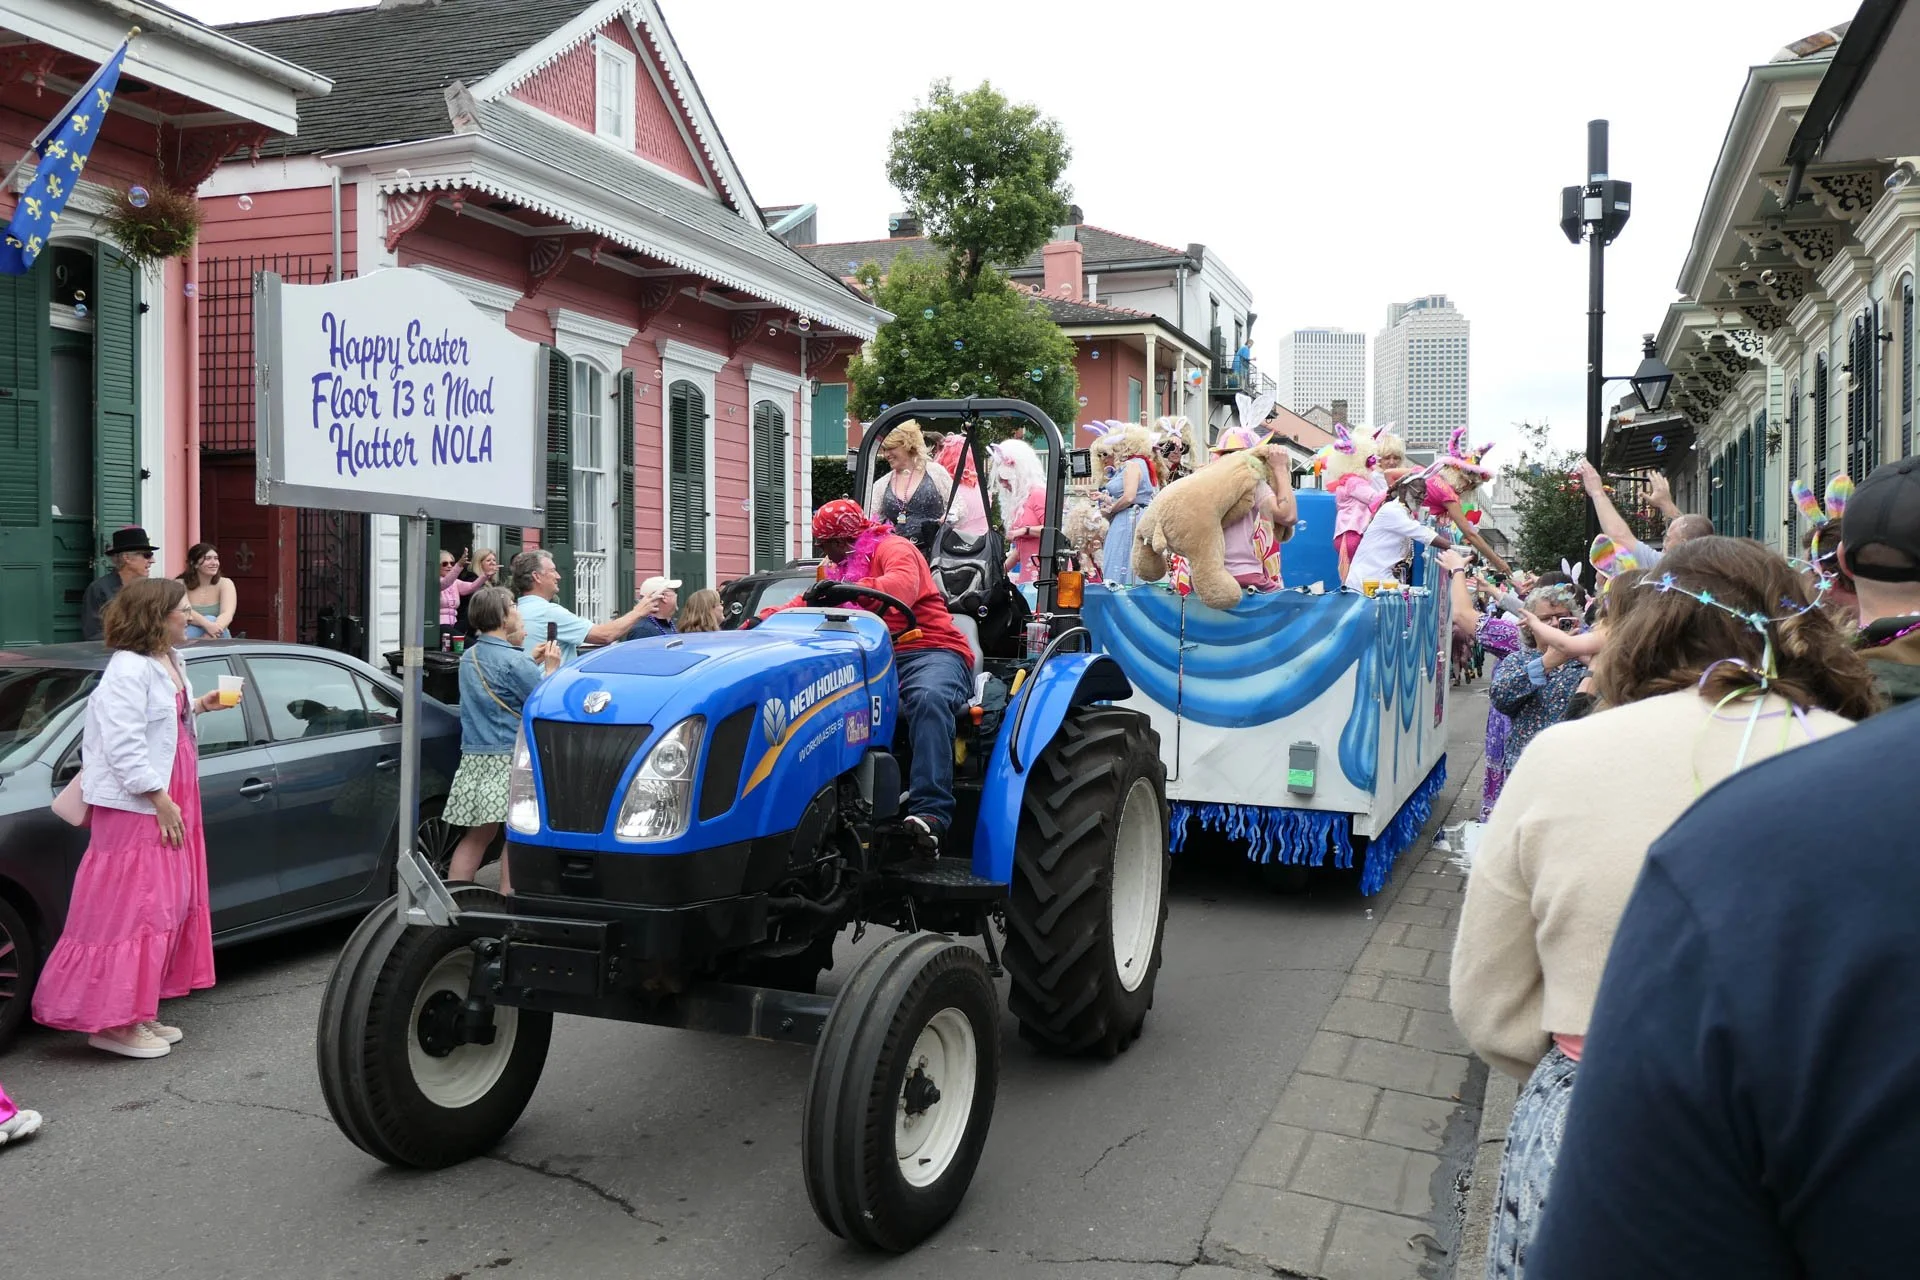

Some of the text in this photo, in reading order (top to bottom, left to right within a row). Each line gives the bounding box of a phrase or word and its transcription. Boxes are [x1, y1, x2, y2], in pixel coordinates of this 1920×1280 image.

[322, 312, 470, 380] Happy Easter
[311, 371, 494, 428] Floor 13 & Mad
[329, 423, 492, 477] Hatter NOLA
[790, 664, 855, 720] NEW HOLLAND
[873, 697, 880, 723] 5
[798, 721, 837, 762] WORKMASTER
